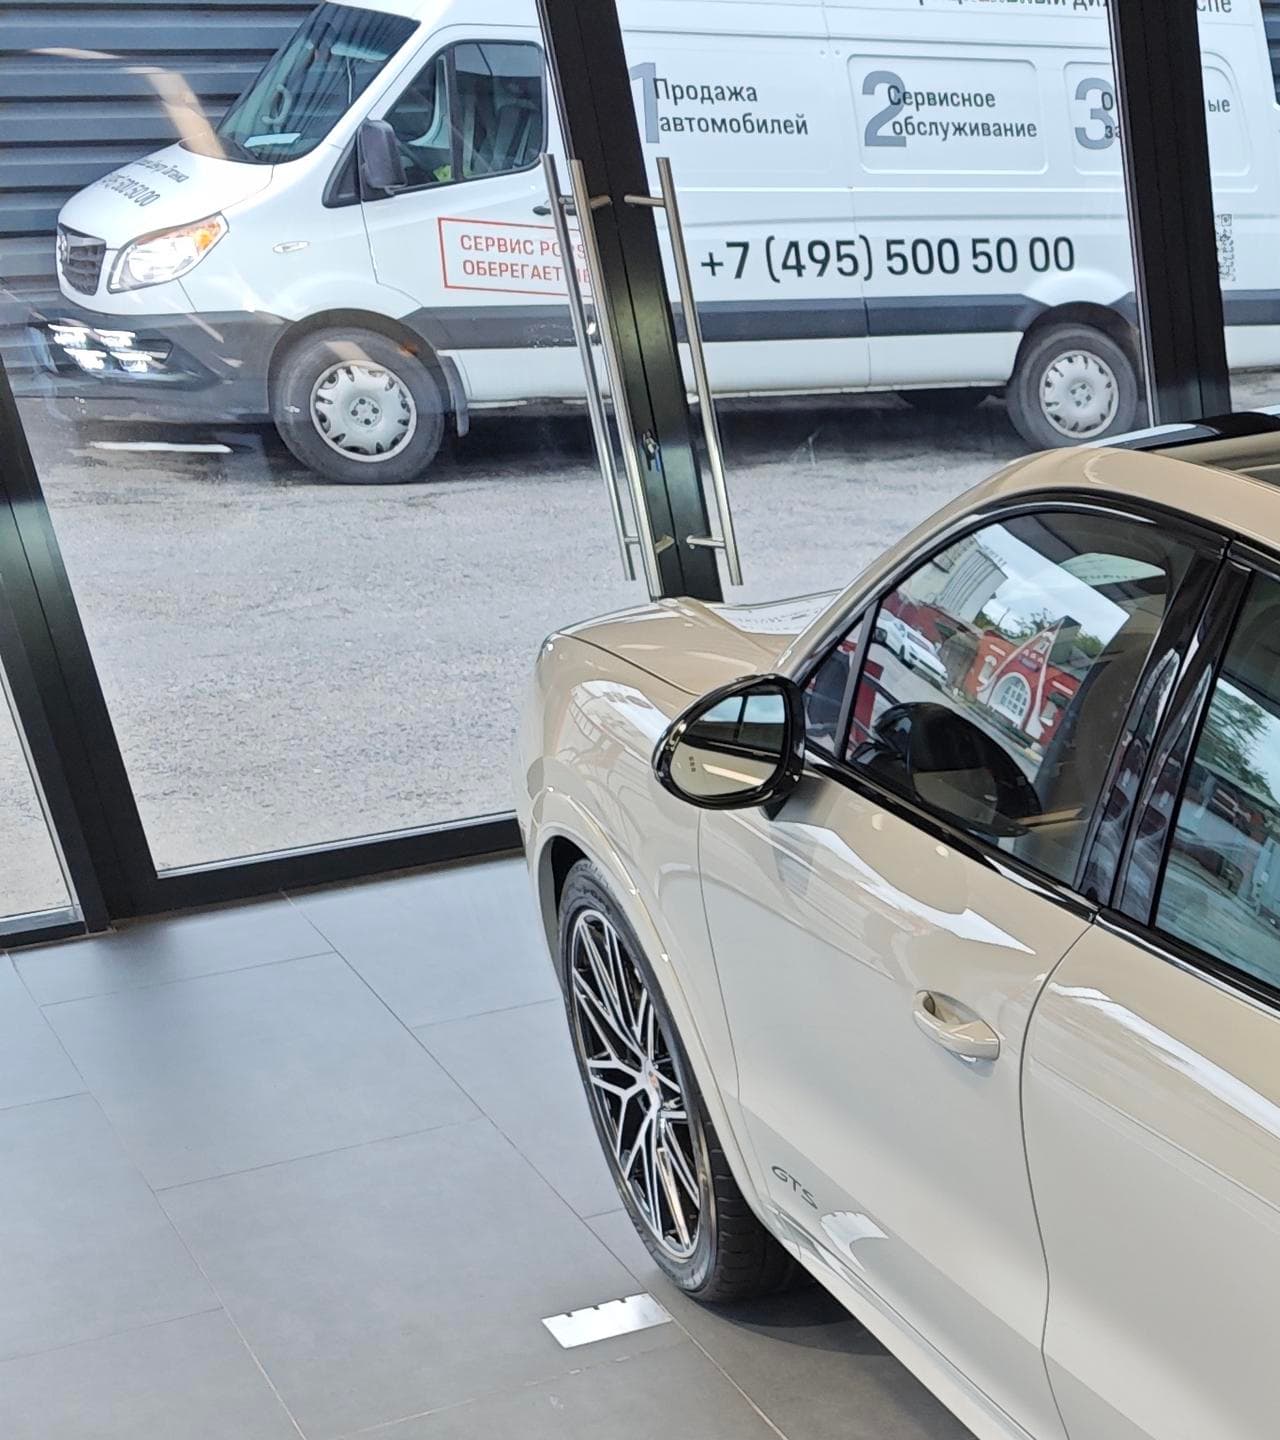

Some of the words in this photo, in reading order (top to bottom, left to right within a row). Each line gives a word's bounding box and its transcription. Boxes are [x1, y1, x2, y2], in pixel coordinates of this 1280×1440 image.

[629, 62, 660, 143] 1
[653, 78, 758, 105] Продажа
[887, 84, 996, 112] Сервисное
[862, 70, 907, 147] 2
[1074, 77, 1117, 150] 3
[660, 113, 809, 135] автомобилей
[892, 115, 1038, 142] обслуживание
[460, 234, 535, 256] СЕРВИС
[700, 241, 750, 280] +7
[765, 233, 874, 284] (495)
[885, 238, 960, 276] 500
[972, 236, 1019, 274] 50
[1028, 236, 1075, 272] 00
[462, 259, 561, 282] ОБЕРЕГАЕТ
[771, 1165, 818, 1210] GTS
